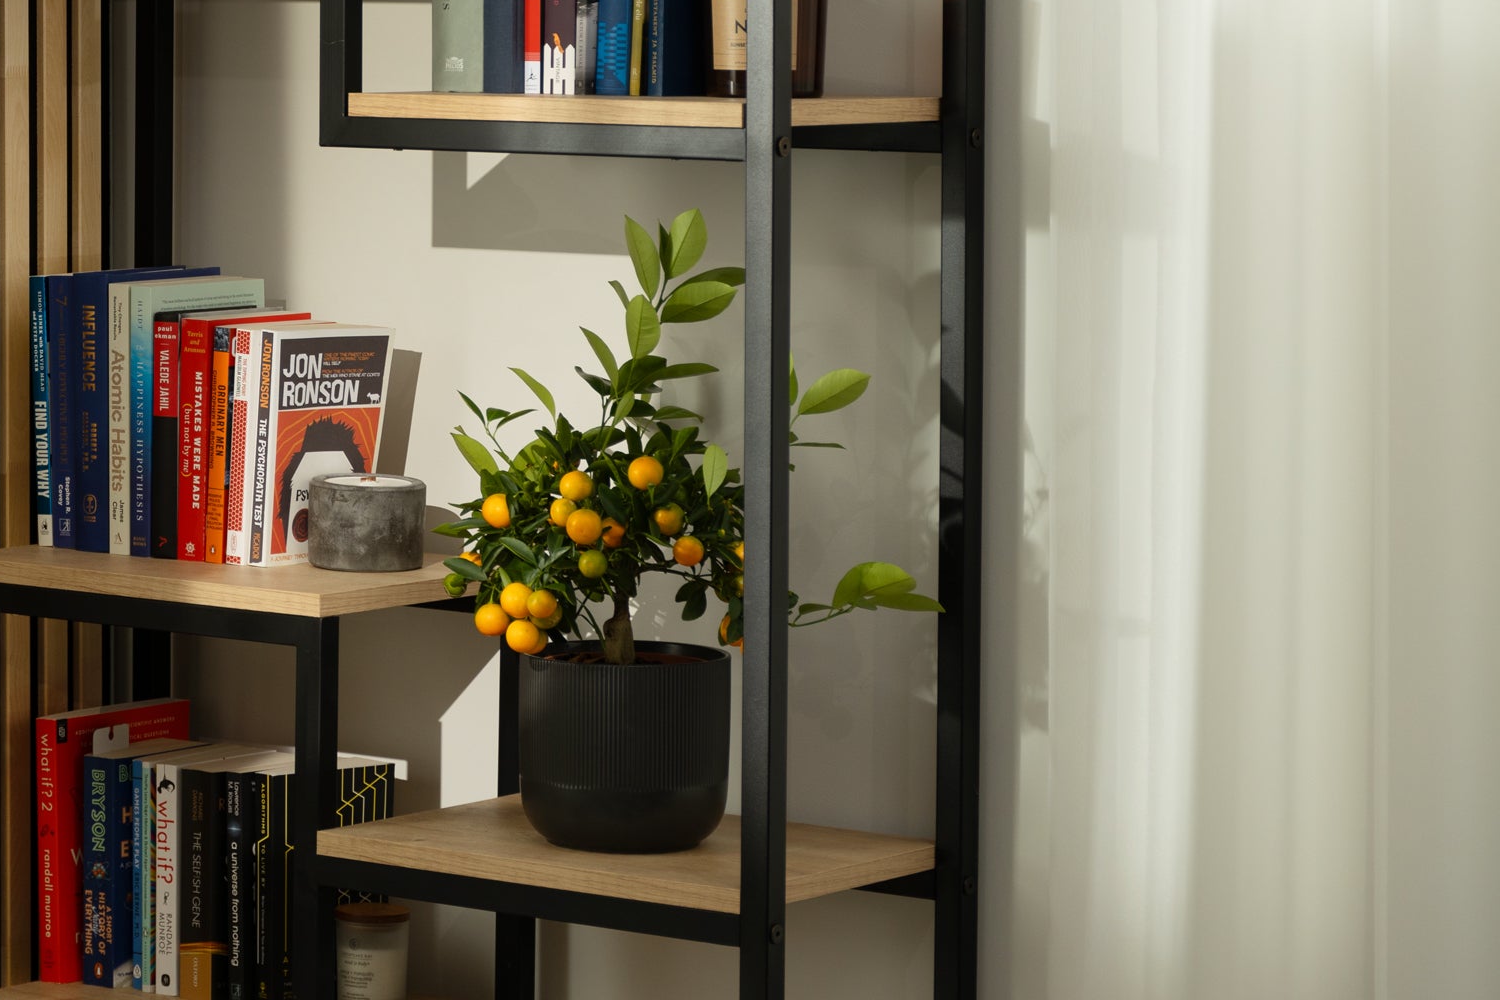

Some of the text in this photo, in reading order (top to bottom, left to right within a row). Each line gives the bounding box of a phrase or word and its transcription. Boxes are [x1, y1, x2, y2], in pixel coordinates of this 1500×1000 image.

[652, 40, 657, 48] JA
[55, 296, 67, 306] 7
[82, 305, 96, 392] INFLUENCE
[282, 353, 323, 380] JON
[159, 350, 170, 411] VALEDE JAHIL
[282, 379, 360, 407] RONSON
[111, 349, 126, 492] Atomic Habits
[182, 404, 193, 424] (but
[216, 385, 226, 457] ORDINARY MEN
[34, 401, 49, 498] FIND YOUR WHY
[182, 446, 191, 456] by
[192, 372, 203, 509] MISTAKES WERE MADE
[252, 339, 272, 559] JON RONSON THE PSYCHOPATH TEST PICADOR
[135, 439, 143, 522] HYPOTHESIS
[181, 459, 192, 477] me)
[40, 734, 52, 775] what
[41, 777, 54, 798] if?
[41, 801, 53, 812] 2
[228, 781, 233, 792] M.
[91, 769, 106, 852] BRYSON
[157, 801, 174, 884] what if?
[192, 832, 202, 851] THE
[261, 844, 266, 855] TO
[44, 849, 53, 891] randall
[192, 854, 202, 893] SELFISH
[261, 878, 266, 888] BY
[84, 889, 93, 955] EVERYTHING
[98, 892, 106, 956] HISTORY OF
[192, 896, 201, 928] GENE
[231, 842, 241, 967] a universe from nothing
